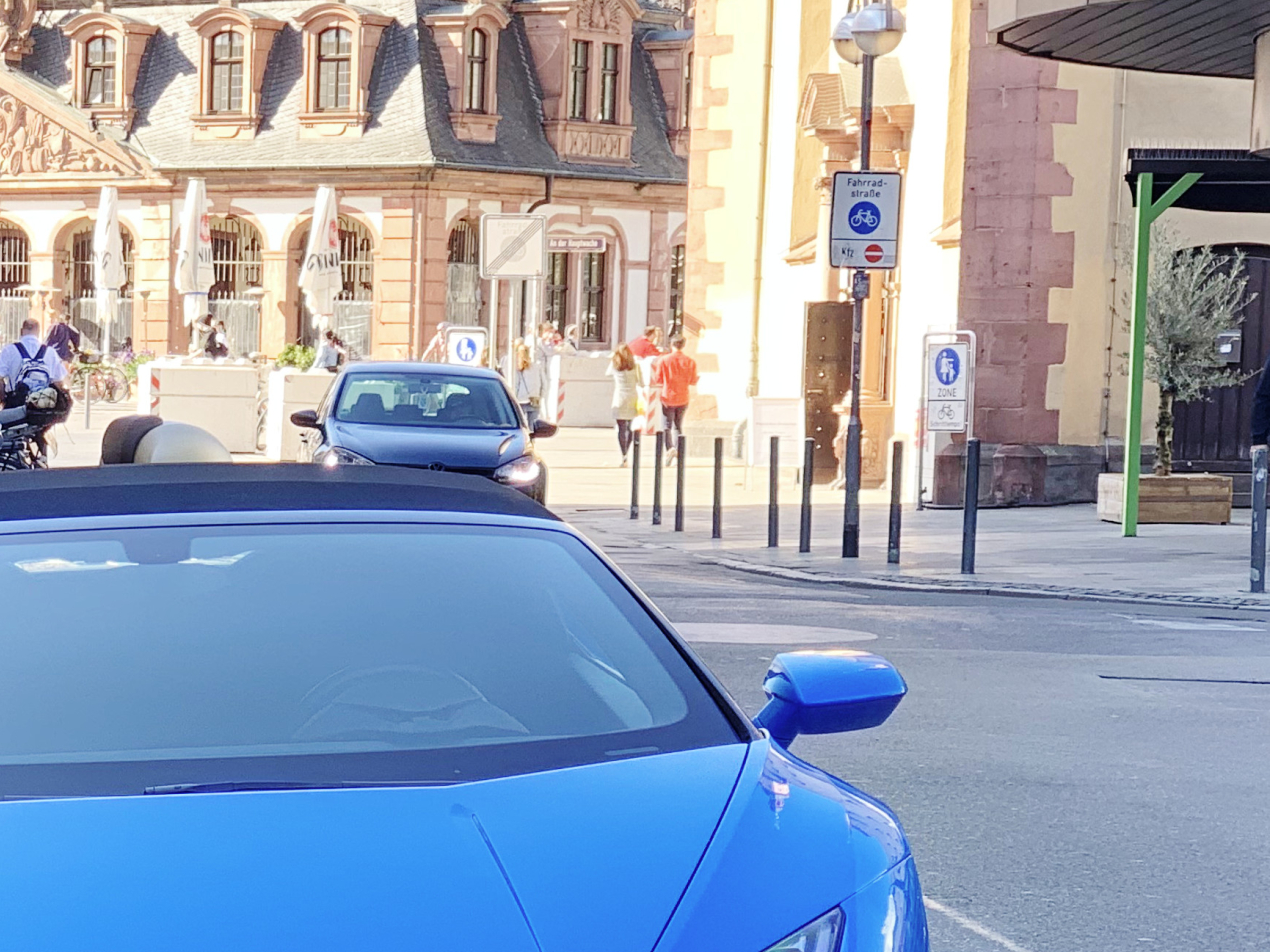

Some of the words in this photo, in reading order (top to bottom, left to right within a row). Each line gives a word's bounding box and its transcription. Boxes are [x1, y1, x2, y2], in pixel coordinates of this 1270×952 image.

[847, 178, 888, 188] Fahrrad-
[851, 189, 881, 198] straße
[841, 248, 855, 258] Kfz
[937, 387, 957, 398] ZONE
